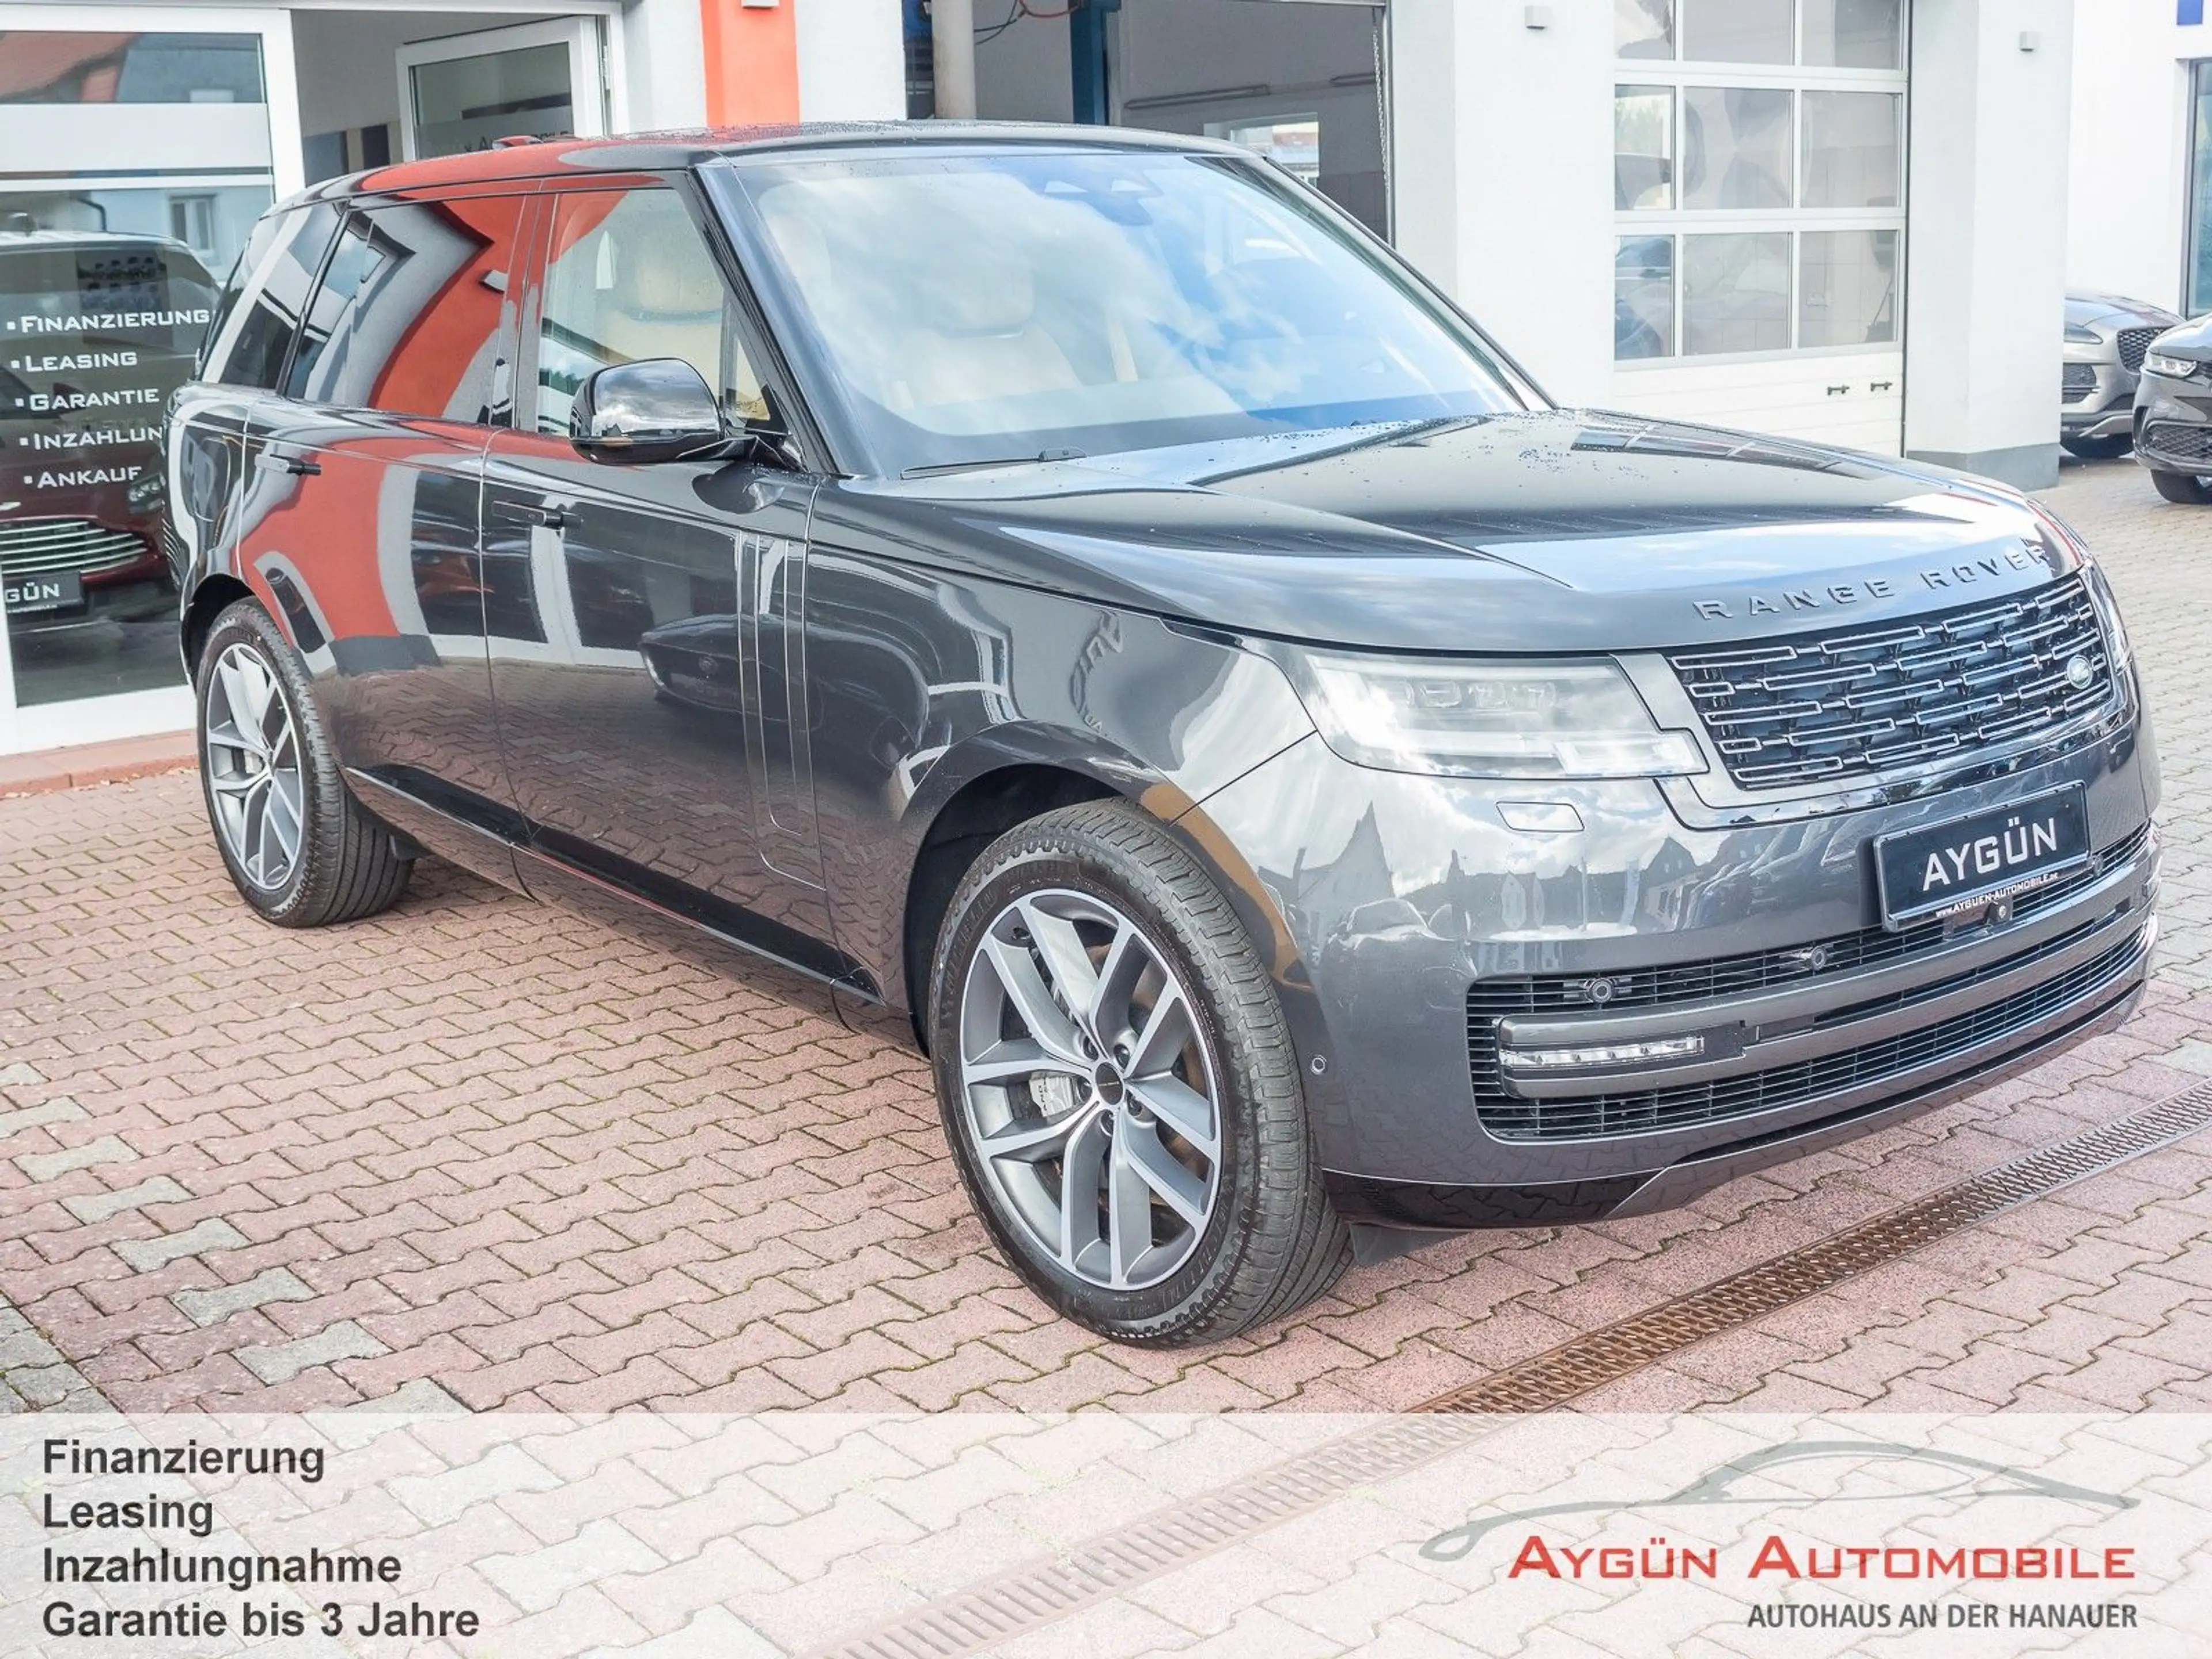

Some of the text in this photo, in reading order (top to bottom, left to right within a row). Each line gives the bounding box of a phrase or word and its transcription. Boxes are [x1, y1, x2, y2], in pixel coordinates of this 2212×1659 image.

[21, 309, 210, 333] FINANZIERUNG
[25, 352, 138, 372] LEASING
[30, 388, 160, 411] GARANTIE
[37, 466, 142, 488] ANKAUF
[1692, 541, 2050, 622] RANGE ROVER
[1922, 816, 2057, 892] AYGÜN
